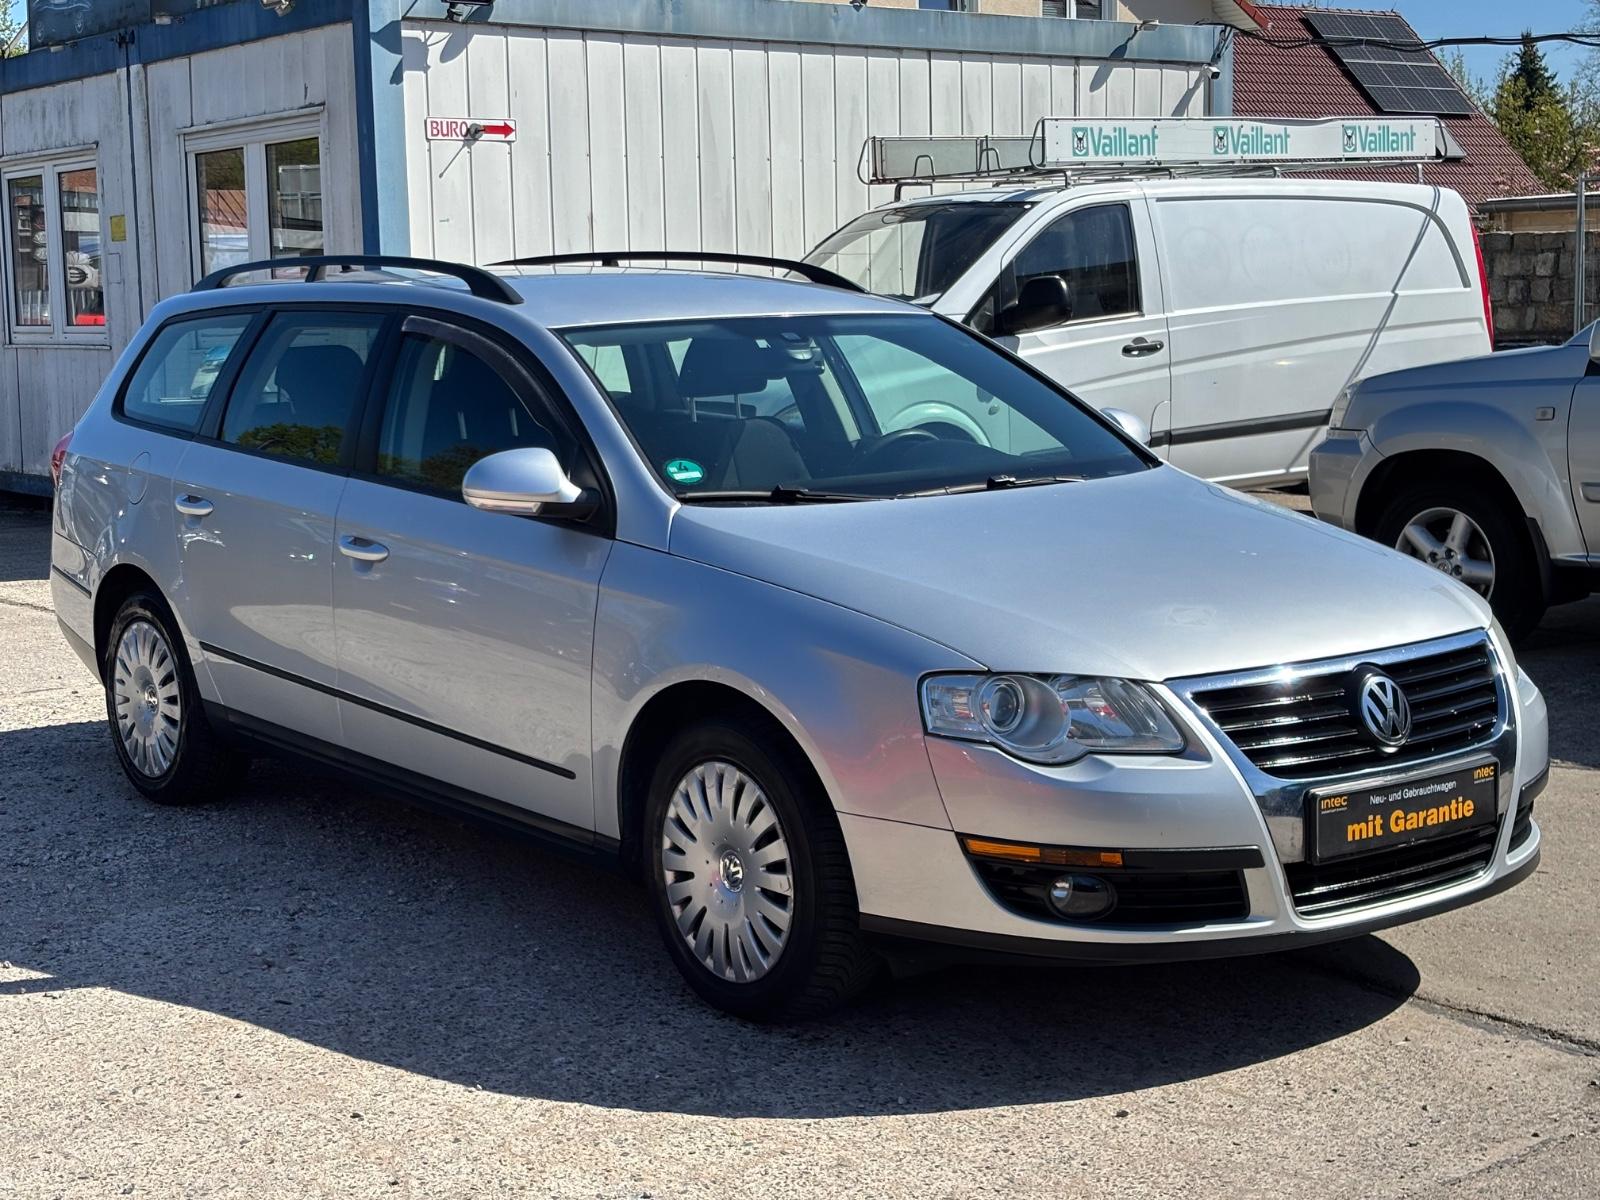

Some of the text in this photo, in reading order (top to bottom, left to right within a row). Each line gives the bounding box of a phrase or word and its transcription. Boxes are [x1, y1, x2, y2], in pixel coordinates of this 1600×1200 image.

[1089, 126, 1159, 157] Vaillant
[1230, 126, 1290, 155] Vaillant
[1358, 125, 1416, 153] Vaillant
[1362, 676, 1409, 745] VW
[1473, 766, 1494, 779] intec
[1321, 796, 1347, 809] intec
[1370, 781, 1457, 805] Neu- und Gebrauchtwagen
[1347, 797, 1474, 842] mit Garantie
